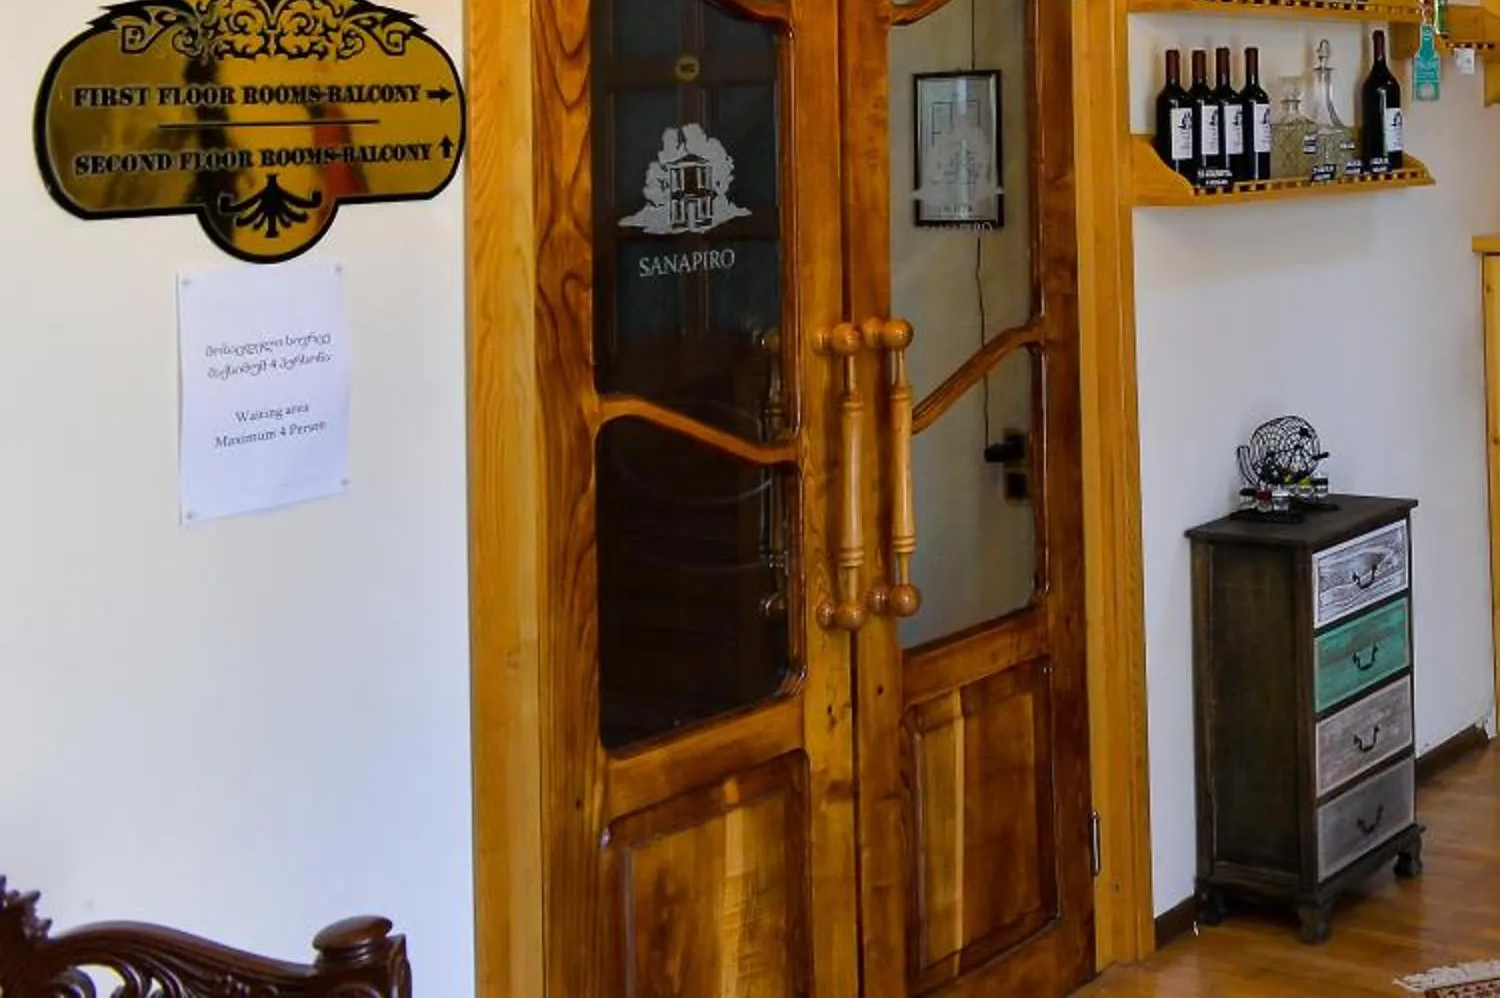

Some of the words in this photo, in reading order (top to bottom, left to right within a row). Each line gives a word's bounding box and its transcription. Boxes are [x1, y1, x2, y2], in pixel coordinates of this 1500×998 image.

[73, 86, 149, 107] FIRST
[157, 85, 236, 106] FLOOR
[242, 84, 422, 105] ROOMS-BALCONY
[74, 152, 173, 177] SECOND
[179, 150, 254, 172] FLOOR
[260, 144, 433, 168] ROOMS-BALCONY
[639, 249, 736, 278] SANAPIRO
[234, 409, 283, 423] Waiting
[285, 404, 310, 415] area
[215, 431, 277, 448] Maximum
[279, 426, 287, 436] 4
